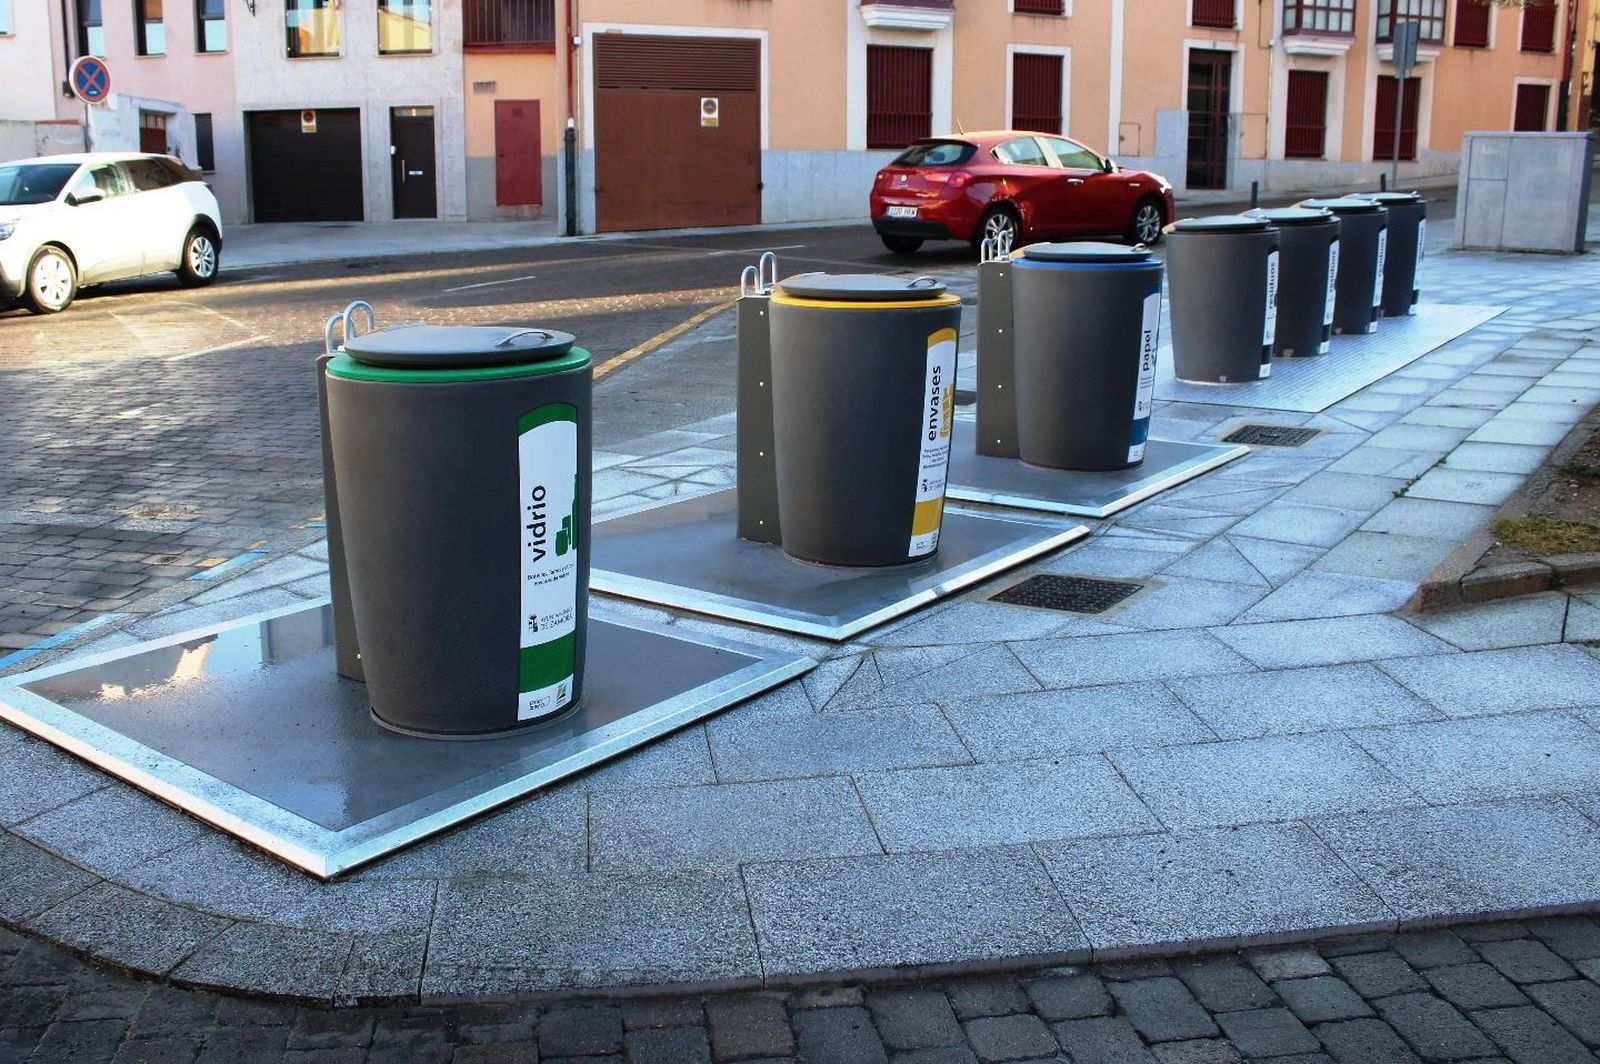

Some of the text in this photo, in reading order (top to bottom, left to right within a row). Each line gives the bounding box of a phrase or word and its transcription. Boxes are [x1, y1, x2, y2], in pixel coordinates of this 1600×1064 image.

[1143, 330, 1152, 371] papel
[928, 365, 941, 441] envases
[526, 485, 546, 563] vidrio
